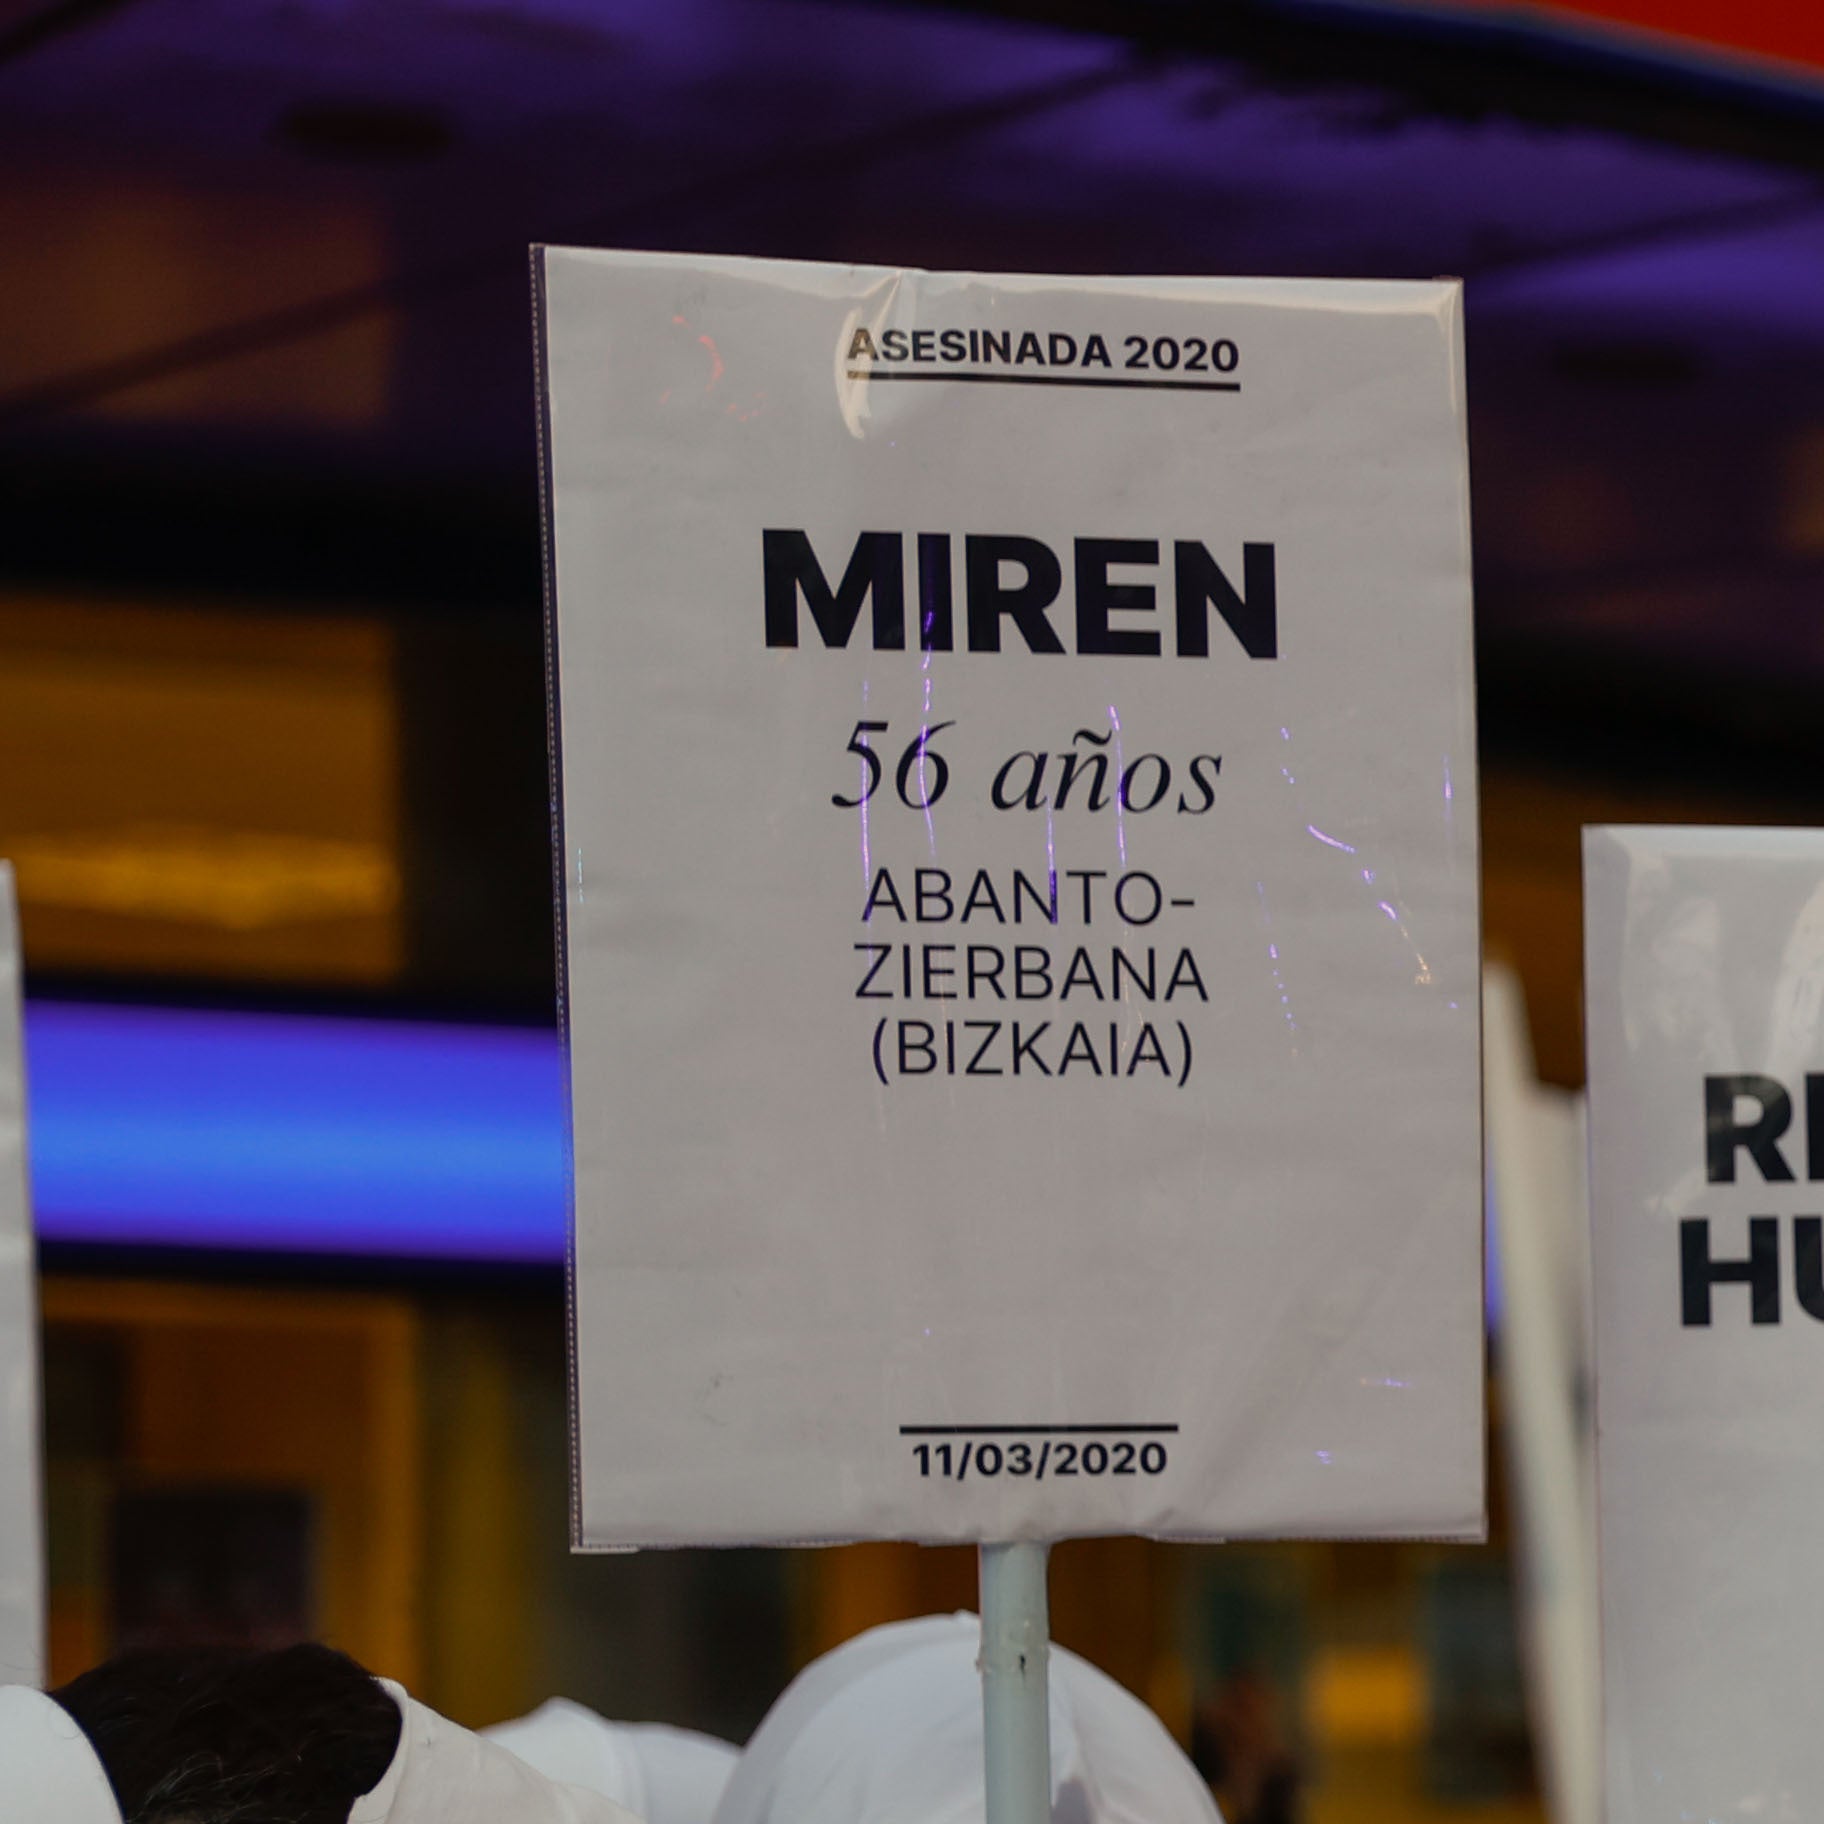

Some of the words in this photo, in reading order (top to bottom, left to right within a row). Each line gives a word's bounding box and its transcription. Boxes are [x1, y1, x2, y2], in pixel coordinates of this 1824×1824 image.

[848, 327, 1112, 369] ASESINADA
[1125, 334, 1240, 372] 2020
[761, 528, 1279, 658] MIREN
[830, 721, 957, 811] 56
[990, 729, 1224, 815] años
[862, 869, 1196, 926] ABANTO-
[853, 943, 1209, 1003] ZIERBANA
[871, 1019, 1195, 1087] (BIZKAIA)
[912, 1442, 1168, 1478] 11/03/2020
